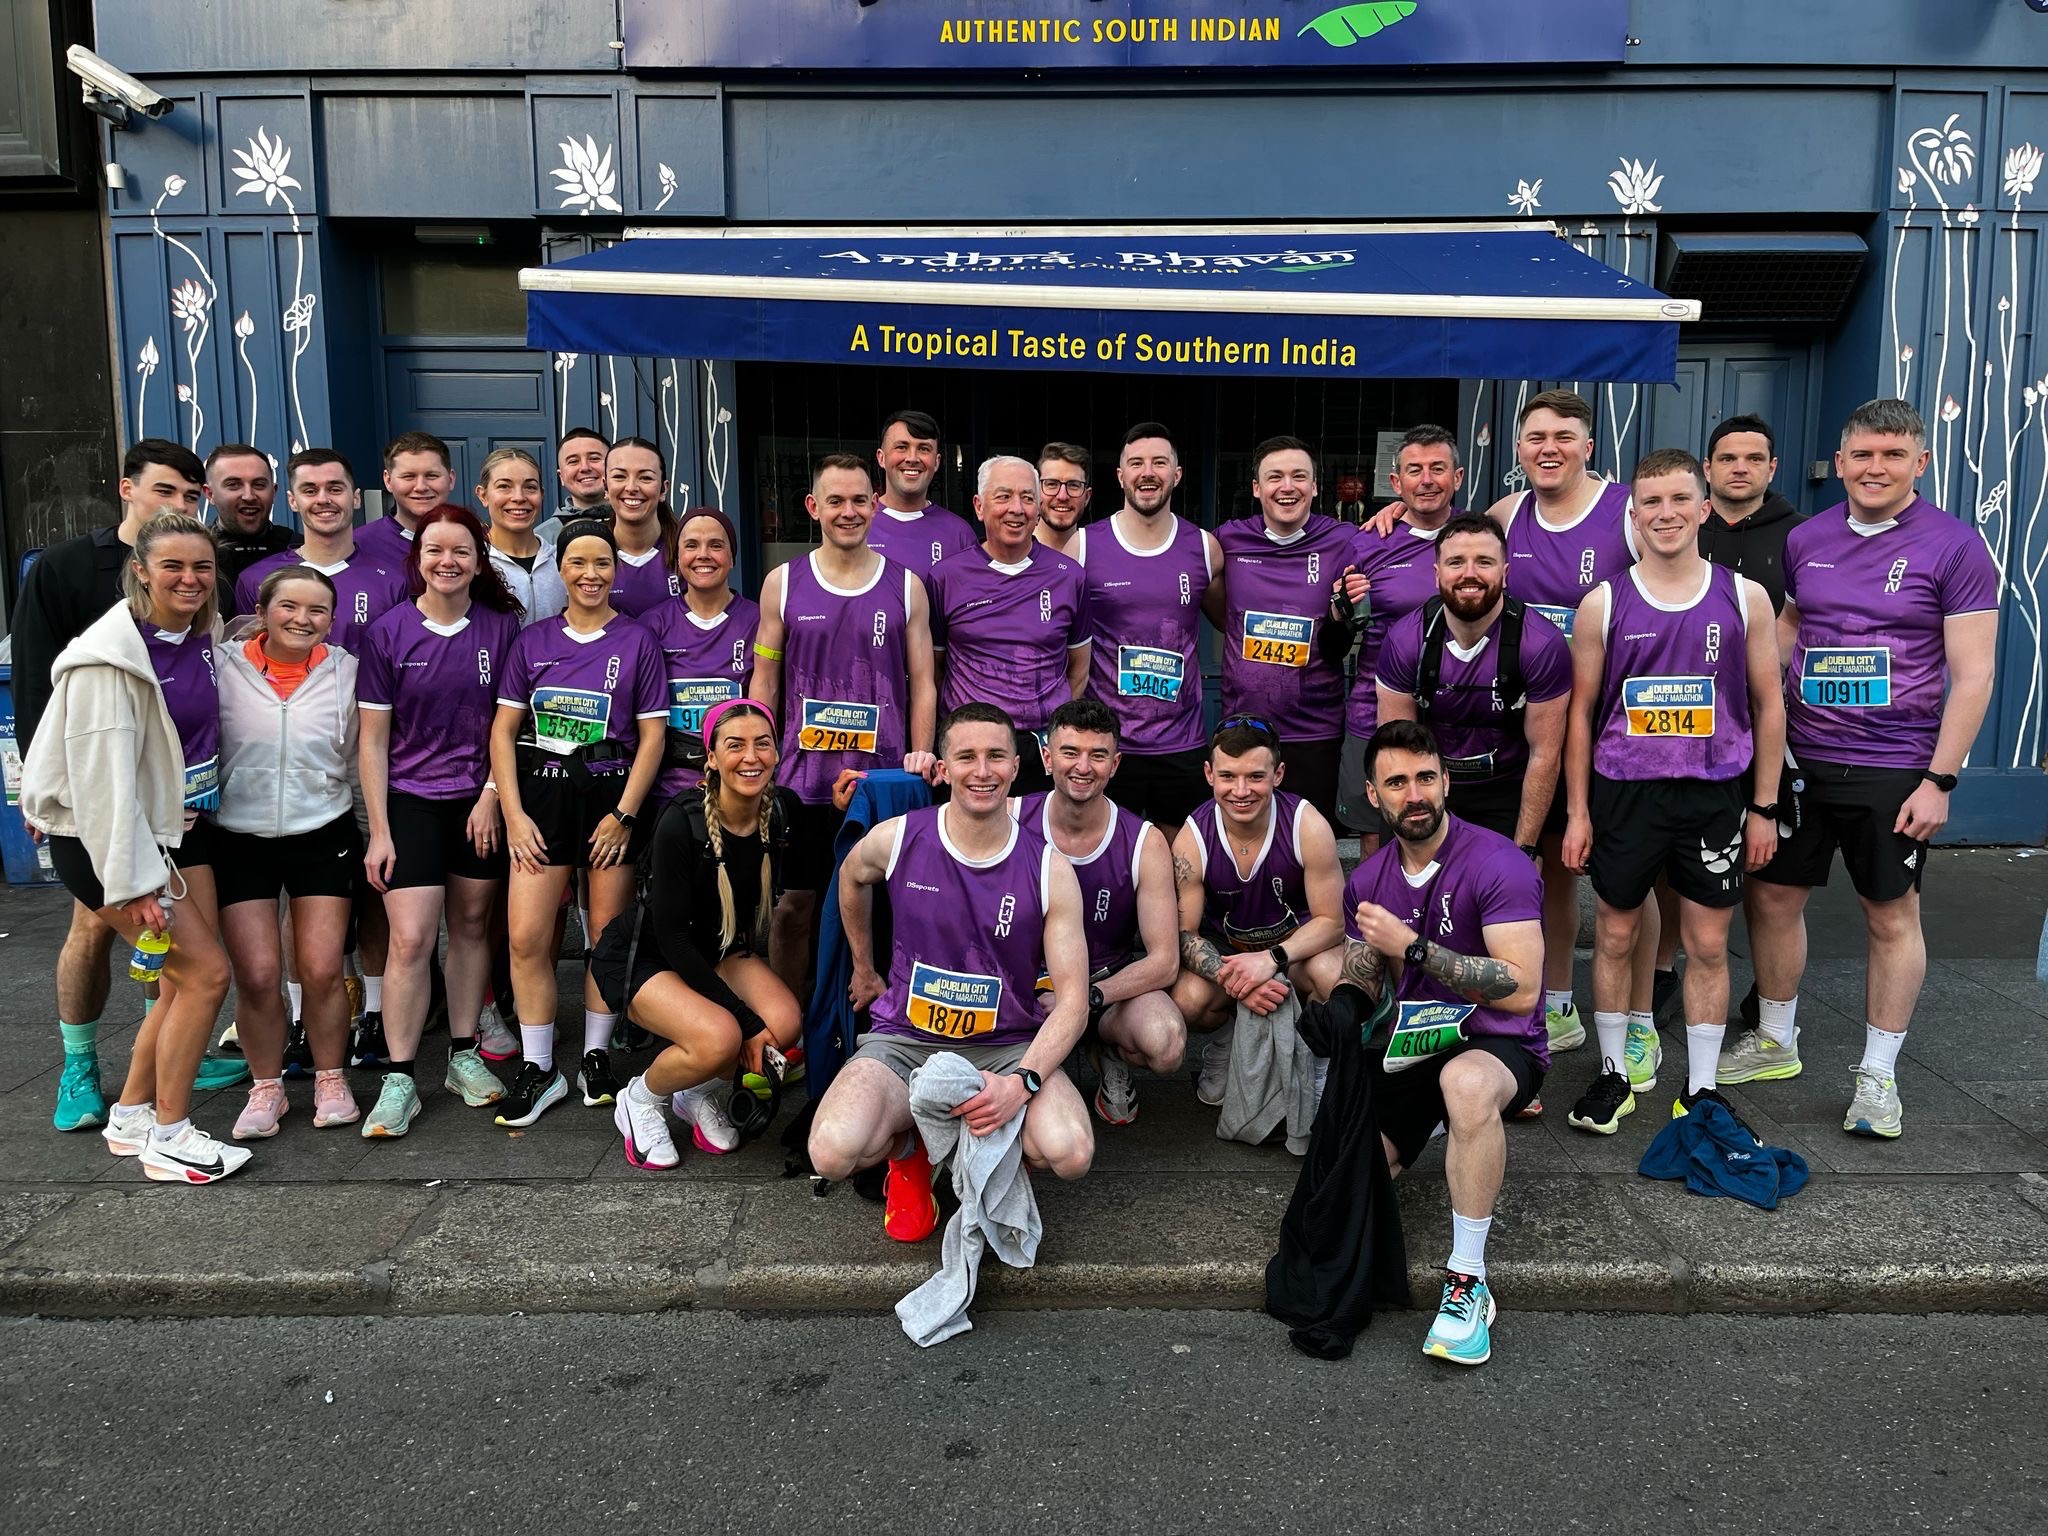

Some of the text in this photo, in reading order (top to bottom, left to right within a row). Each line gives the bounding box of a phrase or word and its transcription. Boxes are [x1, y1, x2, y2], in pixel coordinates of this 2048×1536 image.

[940, 17, 1281, 43] AUTHENTIC SOUTH INDIAN
[926, 265, 1055, 273] AUTHENTIC
[850, 324, 1357, 367] A Tropical Taste of Southern India
[1266, 620, 1304, 631] DUBLIN CITY
[1252, 640, 1297, 663] 2443
[1142, 653, 1176, 666] DUBLIN CITY
[1828, 655, 1876, 665] DUBLIN CITY
[689, 685, 731, 695] DUBLIN CITY
[1132, 673, 1169, 698] 9406
[1654, 683, 1703, 694] DUBLIN CITY
[1817, 680, 1870, 704] 10911
[557, 695, 600, 708] DUBLIN CITY
[1653, 693, 1704, 703] HALF MARATHON
[682, 708, 700, 729] 91
[827, 707, 869, 720] DUBLIN CITY
[547, 717, 591, 742] 5545
[1644, 710, 1695, 734] 2814
[813, 729, 860, 750] 2794
[941, 979, 990, 994] DUBLIN CITY
[940, 989, 988, 1003] HALF MARATHON
[928, 1004, 976, 1035] 1870
[1421, 1006, 1461, 1018] DUBLIN CITY
[1401, 1028, 1441, 1055] 6102
